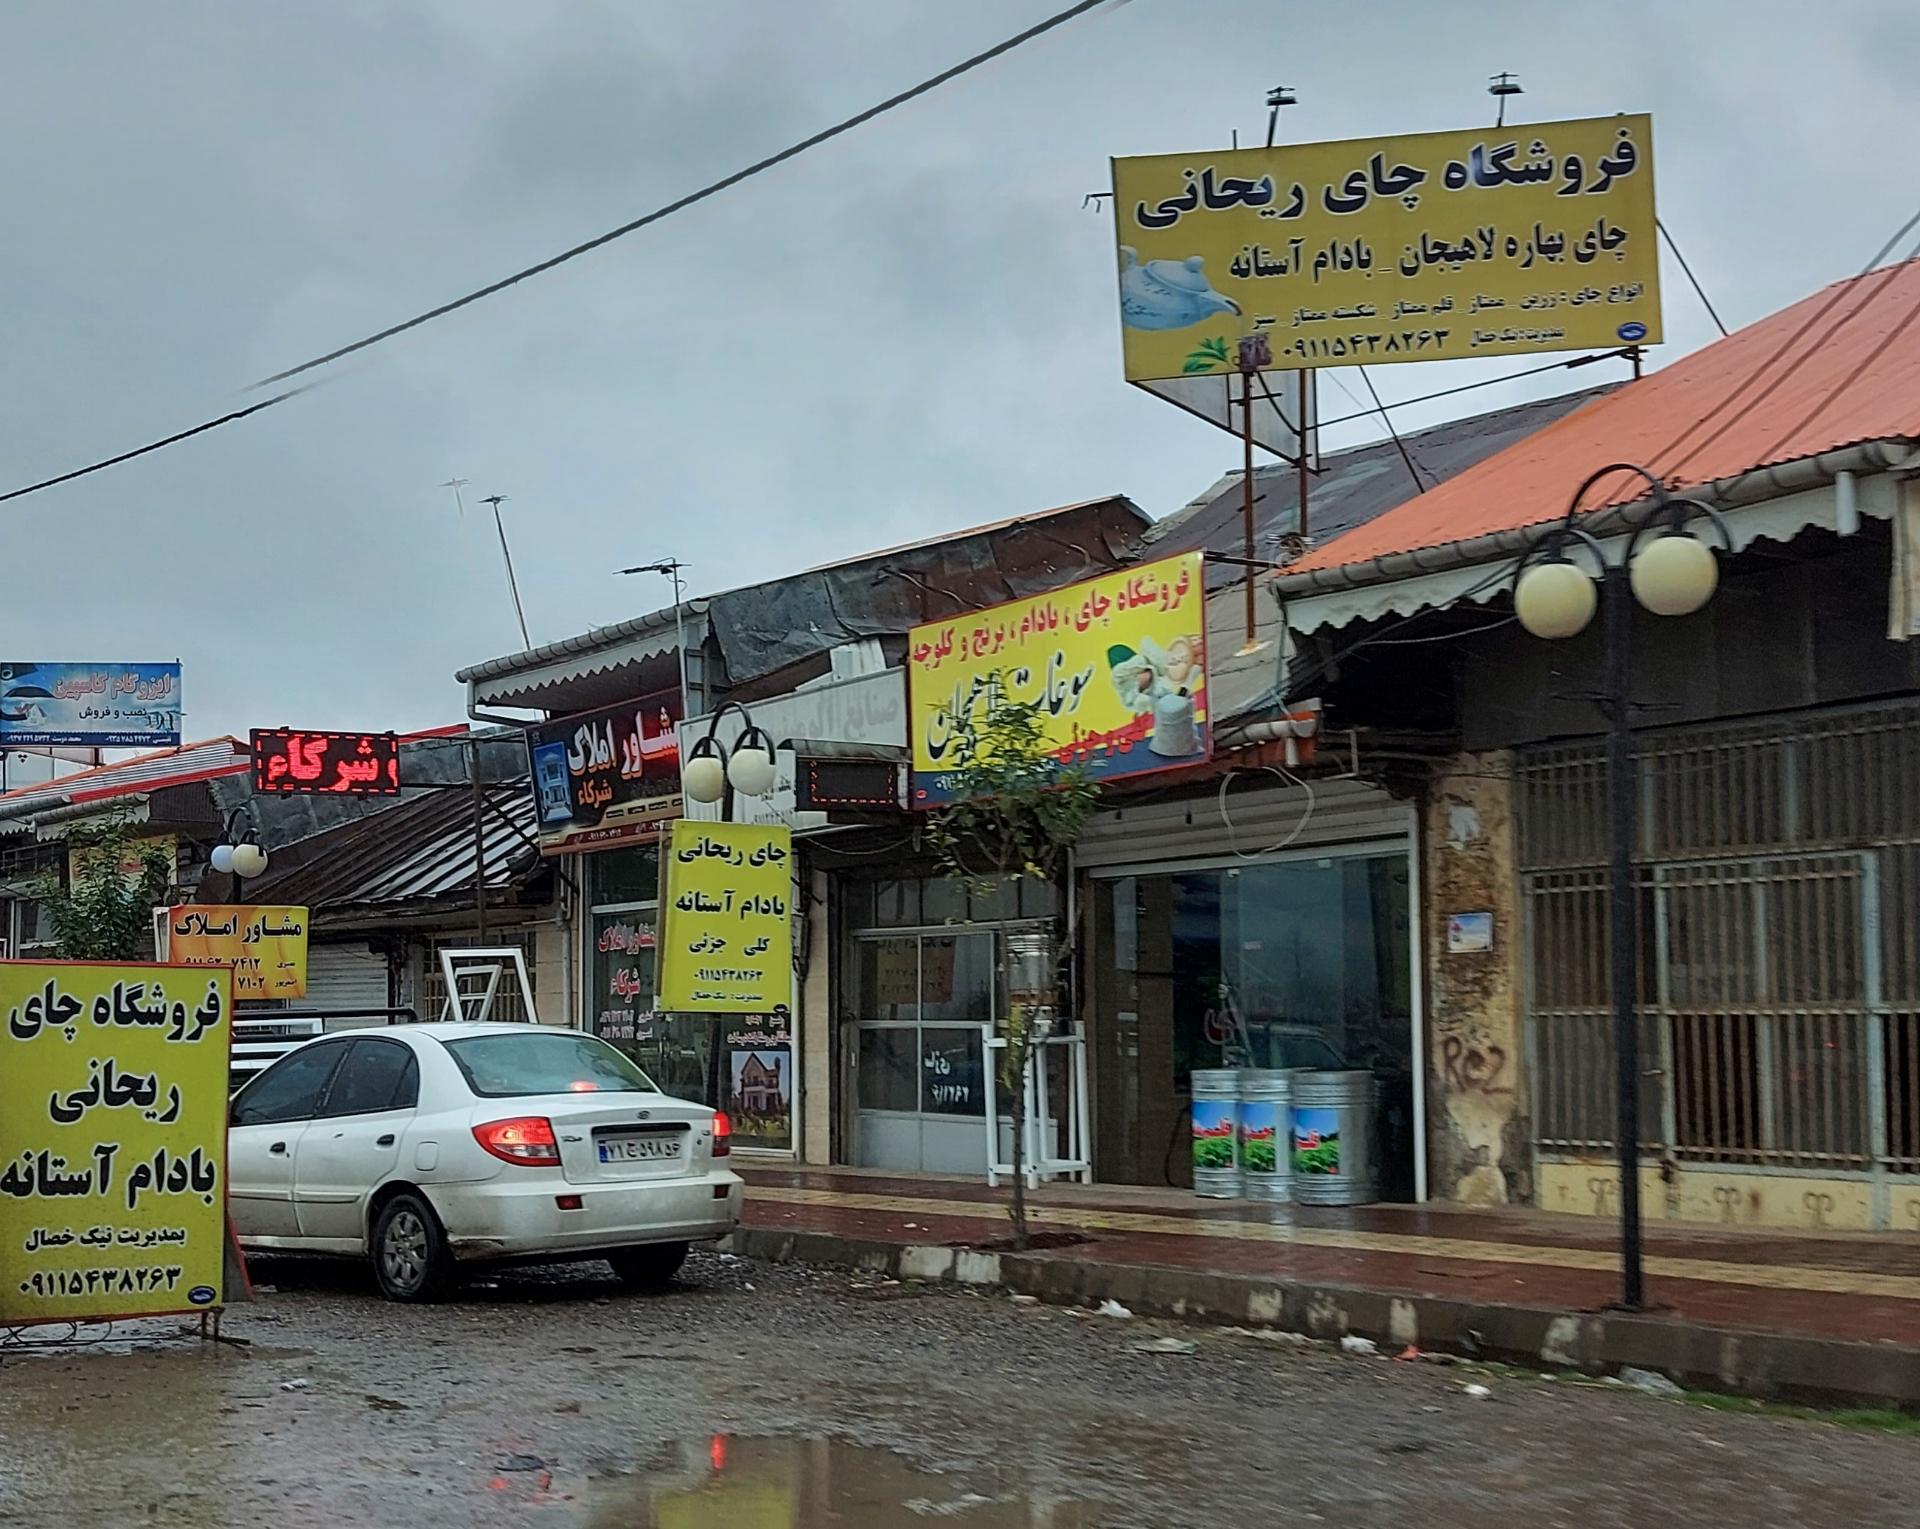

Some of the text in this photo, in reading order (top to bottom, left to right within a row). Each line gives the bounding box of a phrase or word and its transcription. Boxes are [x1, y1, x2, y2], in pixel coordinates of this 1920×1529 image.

[1138, 129, 1636, 227] فروشگاه چای ریحانی
[1230, 219, 1627, 283] چای بهاره لاهیجان بادام آستانه
[1608, 283, 1643, 303] انواع
[1292, 308, 1327, 327] ممتاز
[1392, 301, 1427, 319] ممتاز
[1284, 330, 1450, 358] ۰۹۱۱۵۴۳۸۲۶۳
[1117, 561, 1190, 613] فروشگاه
[973, 619, 1004, 657] برنج
[1020, 601, 1058, 645] بادام
[913, 628, 954, 671] کلوچه
[961, 636, 968, 660] و
[54, 673, 172, 700] ایزوگام کاسپین
[79, 706, 147, 720] نصب و فروش
[568, 718, 616, 776] املاک
[621, 706, 679, 780] شاور
[678, 837, 787, 869] چای ریحانی
[675, 890, 785, 920] بادام آستانه
[175, 913, 301, 943] مشاور املاک
[744, 937, 770, 956] کلی
[11, 980, 220, 1041] فروشگاه چای
[50, 1059, 180, 1122] ریحانی
[1, 1145, 216, 1209] بادام آستانه
[25, 1228, 186, 1251] بمدیریت نیک خصال
[19, 1267, 181, 1296] ۰۹۱۱۵۴۳۸۲۶۳
